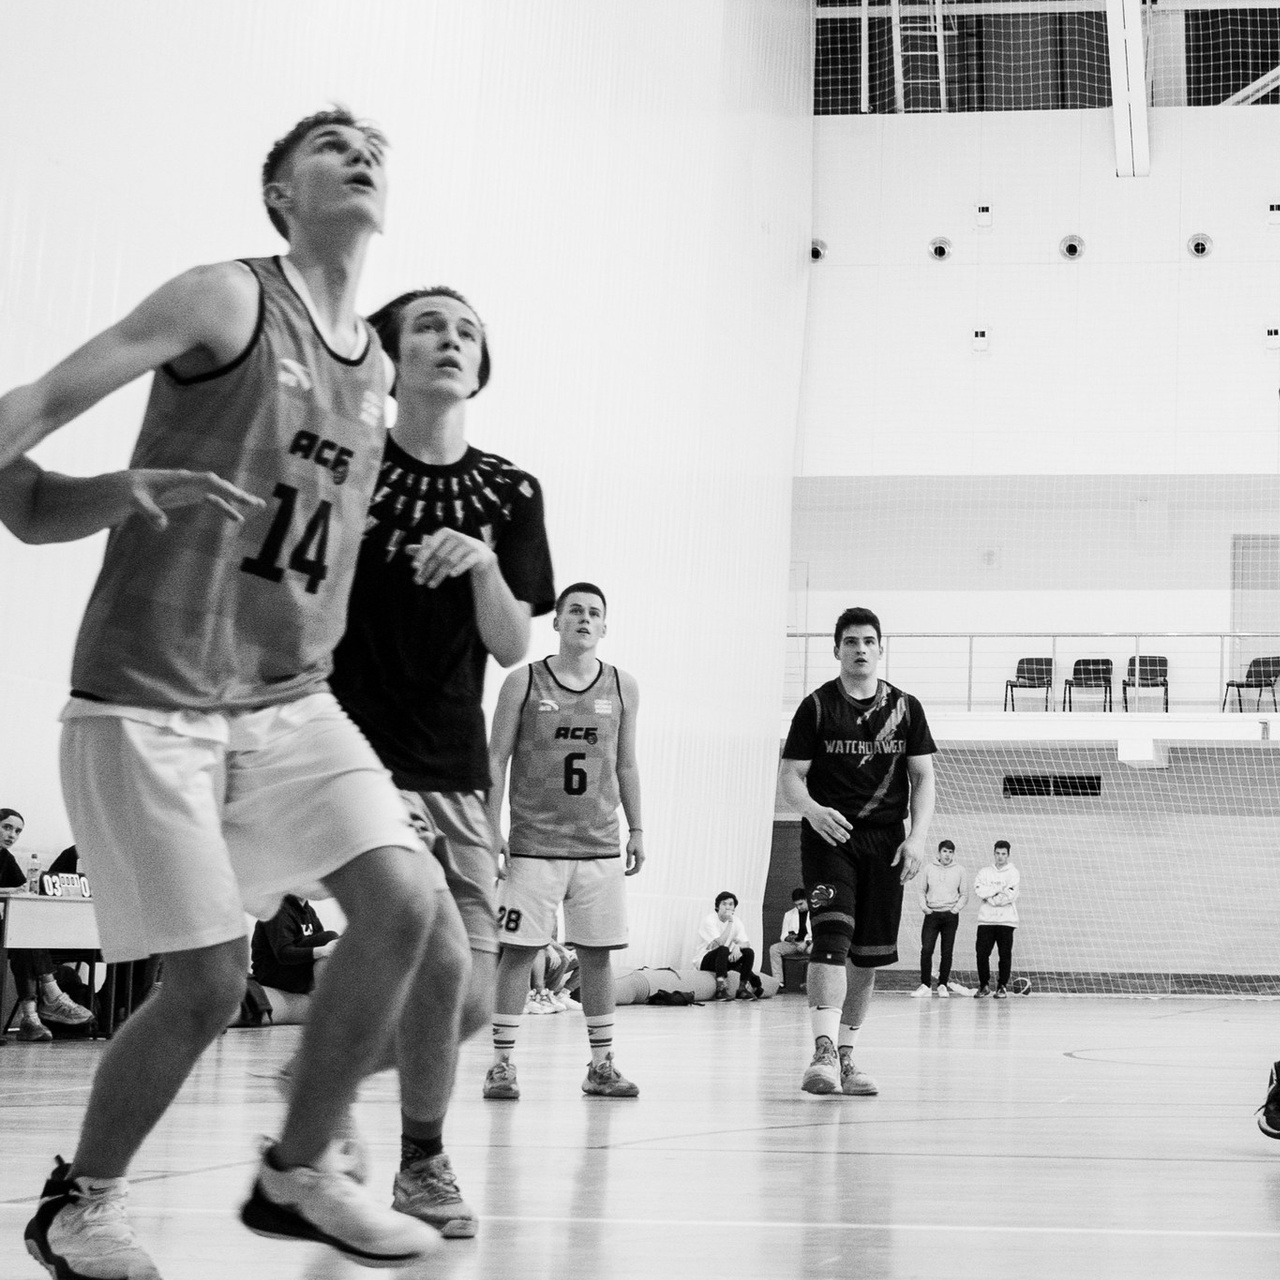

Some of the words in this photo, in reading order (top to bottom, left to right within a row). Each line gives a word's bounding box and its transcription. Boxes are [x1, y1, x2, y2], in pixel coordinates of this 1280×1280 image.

[240, 482, 331, 594] 14
[563, 752, 587, 796] 6
[43, 874, 62, 897] 03
